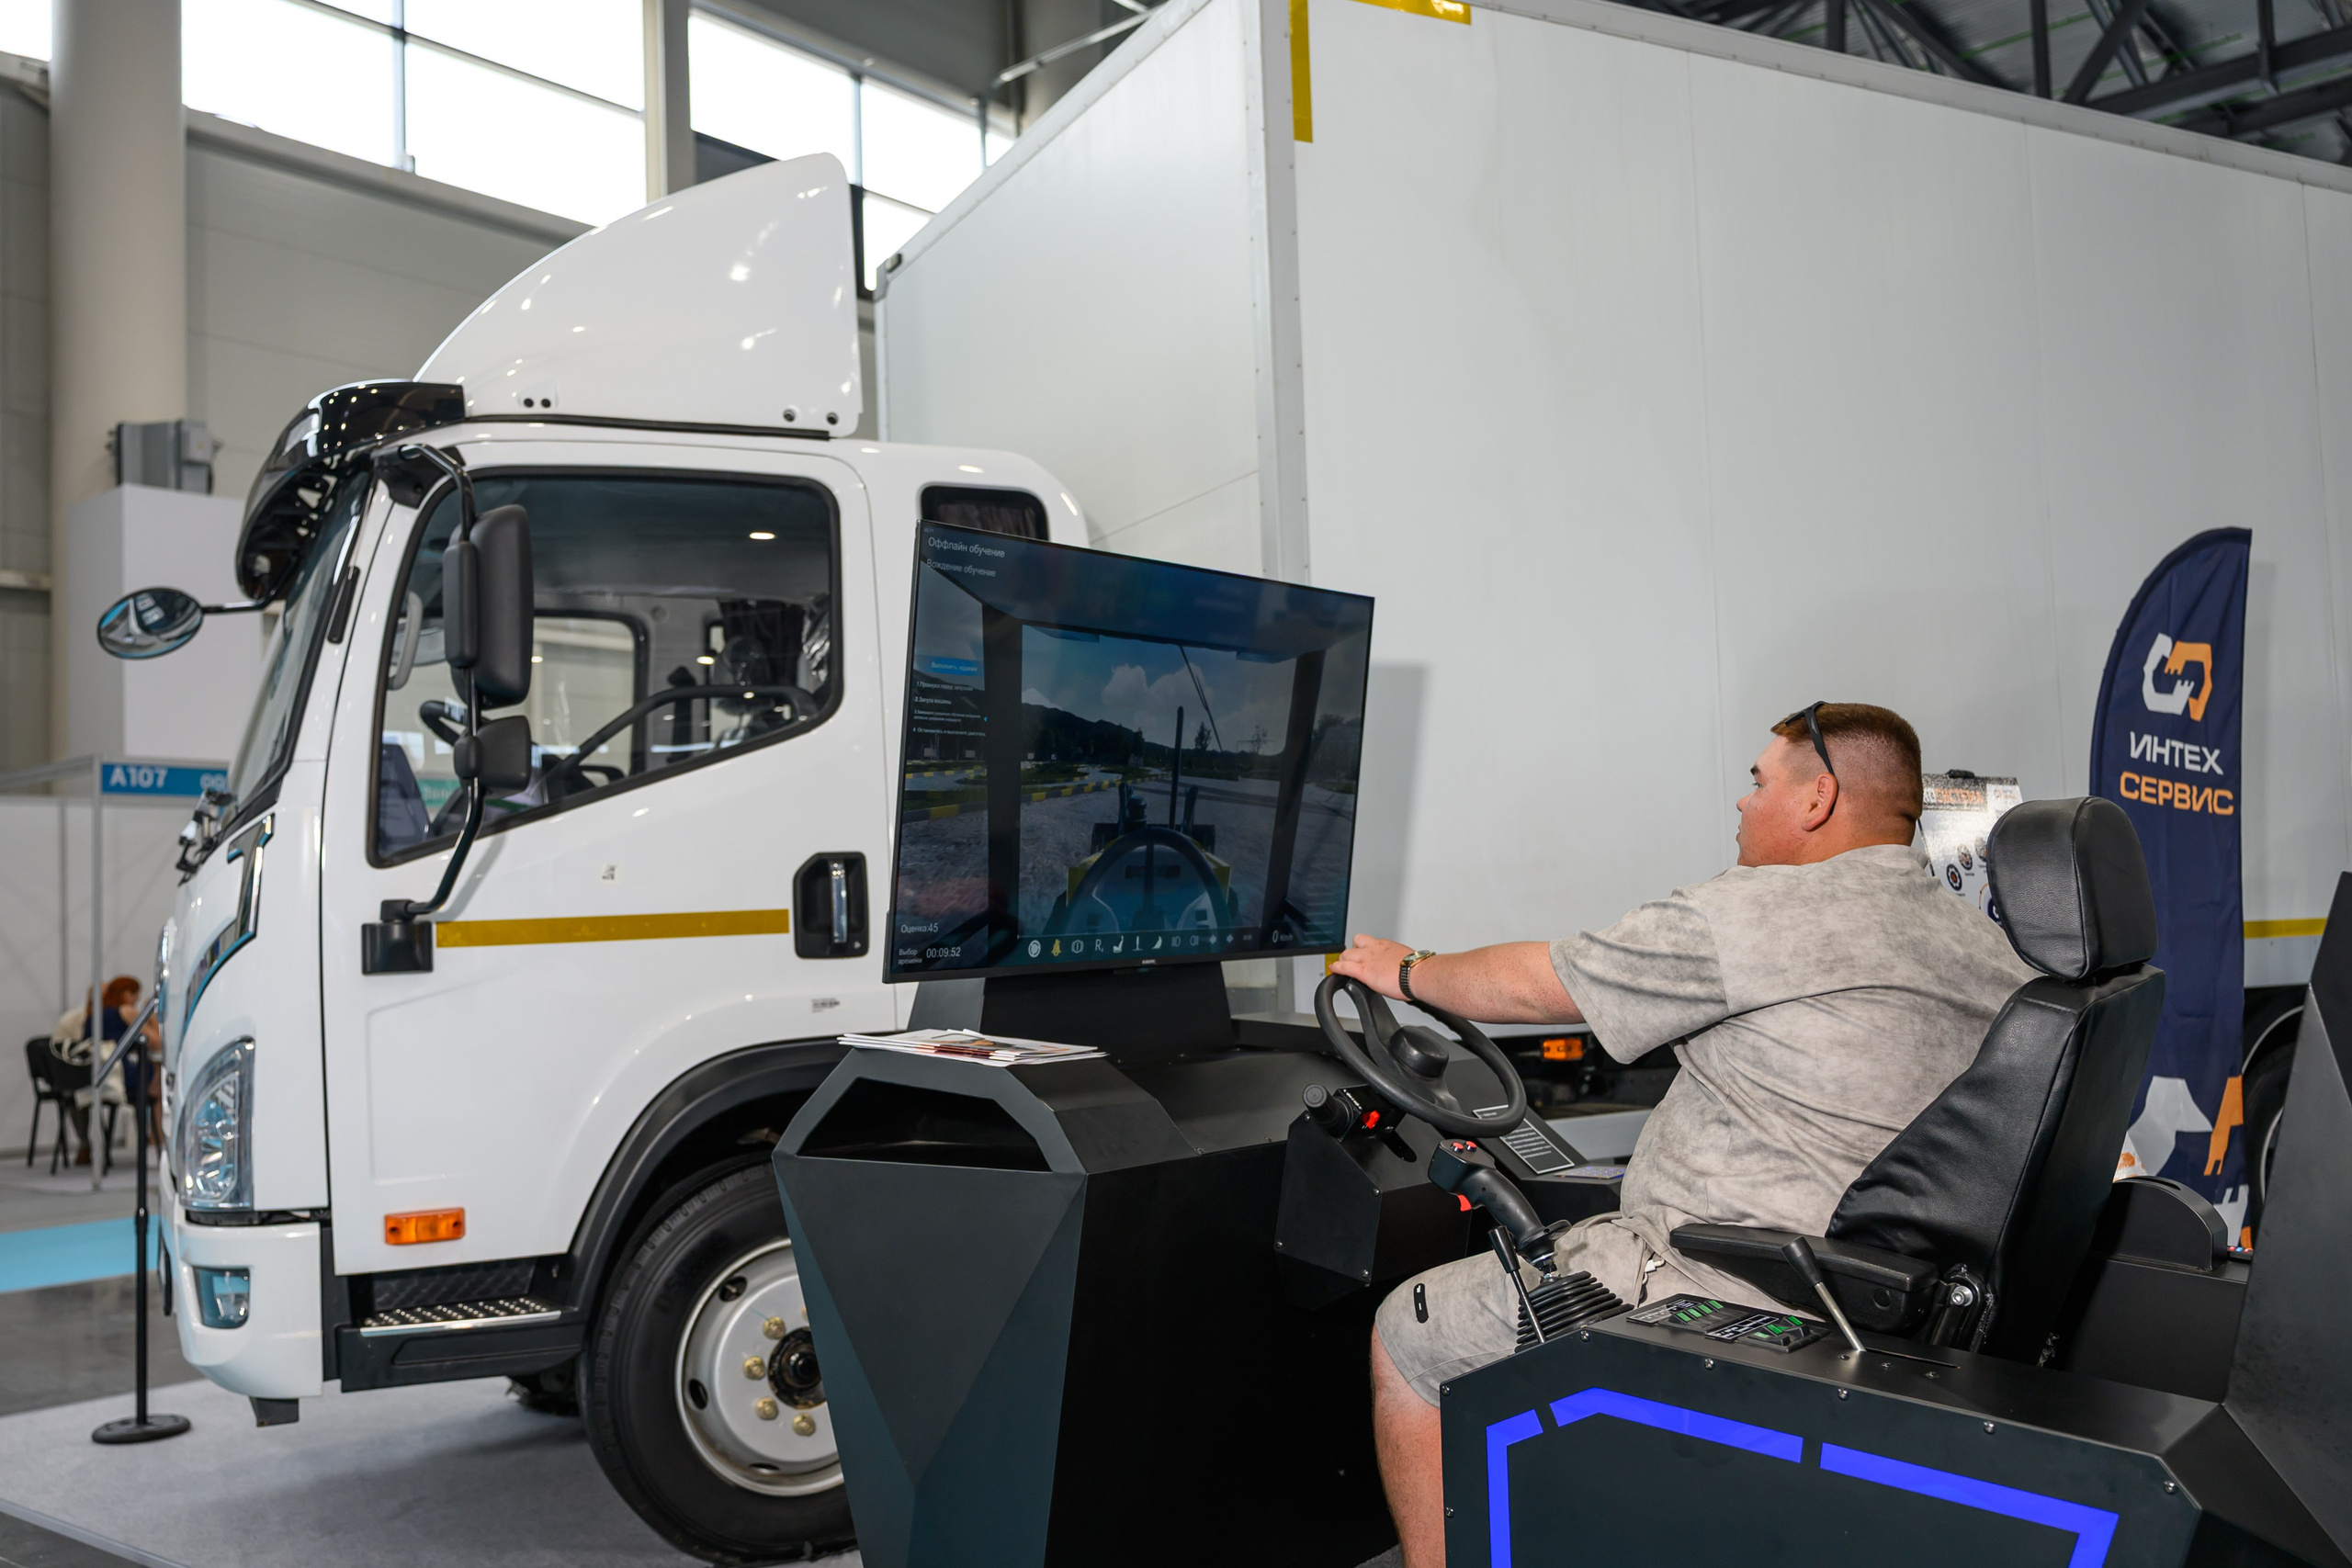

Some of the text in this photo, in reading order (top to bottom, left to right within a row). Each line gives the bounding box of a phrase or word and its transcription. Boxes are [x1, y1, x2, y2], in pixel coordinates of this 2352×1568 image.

[928, 536, 1005, 558] Оффлайн обучение
[926, 558, 996, 577] Вождение обучение
[2129, 730, 2223, 775] ИНТЕХ
[109, 765, 168, 789] A107
[2119, 771, 2234, 817] СЕРВИС
[899, 948, 918, 956] Выбор
[926, 947, 961, 958] 00:09:52
